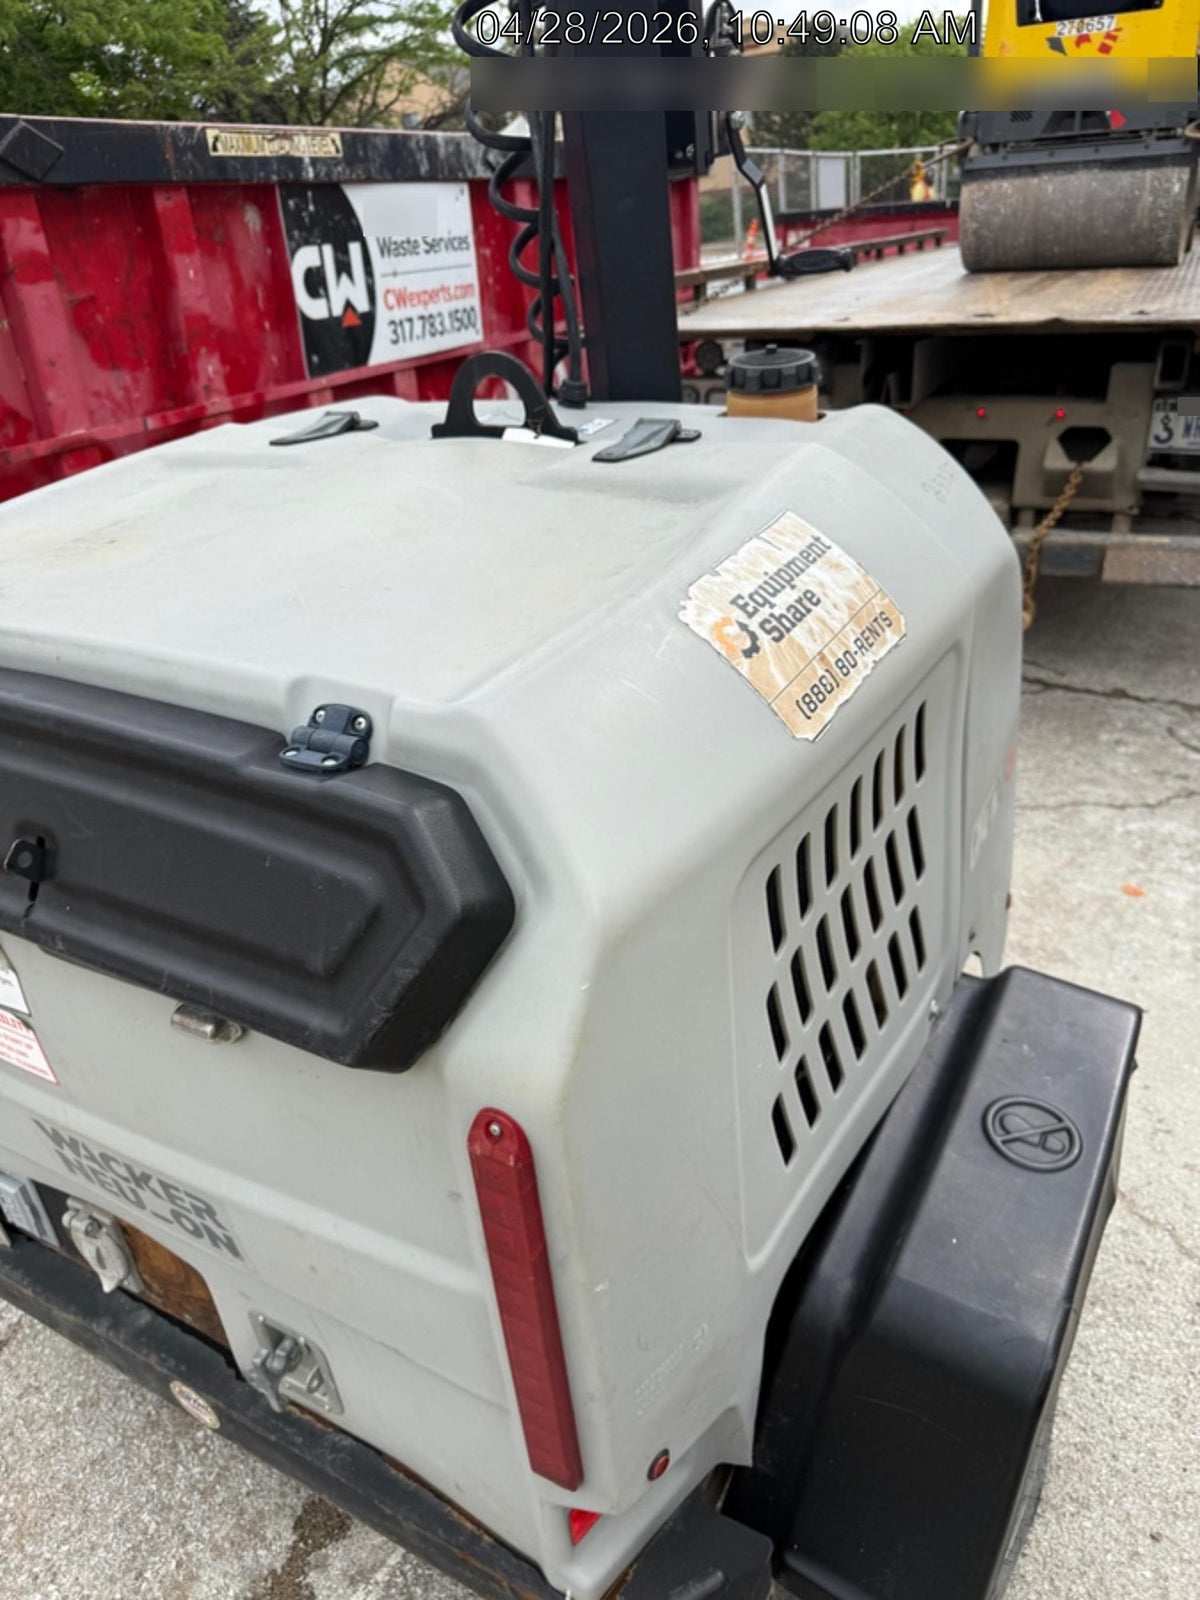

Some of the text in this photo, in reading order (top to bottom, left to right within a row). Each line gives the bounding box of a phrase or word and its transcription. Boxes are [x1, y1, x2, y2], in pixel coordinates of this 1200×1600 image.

[376, 233, 471, 259] Waste Services
[291, 241, 371, 320] CW
[383, 283, 476, 311] CWexperts.com
[388, 305, 478, 345] 317.783.1500
[729, 534, 833, 620] Equipment
[758, 587, 822, 643] Share
[834, 610, 894, 678] 80-RENTS
[32, 1118, 230, 1233] WACKER
